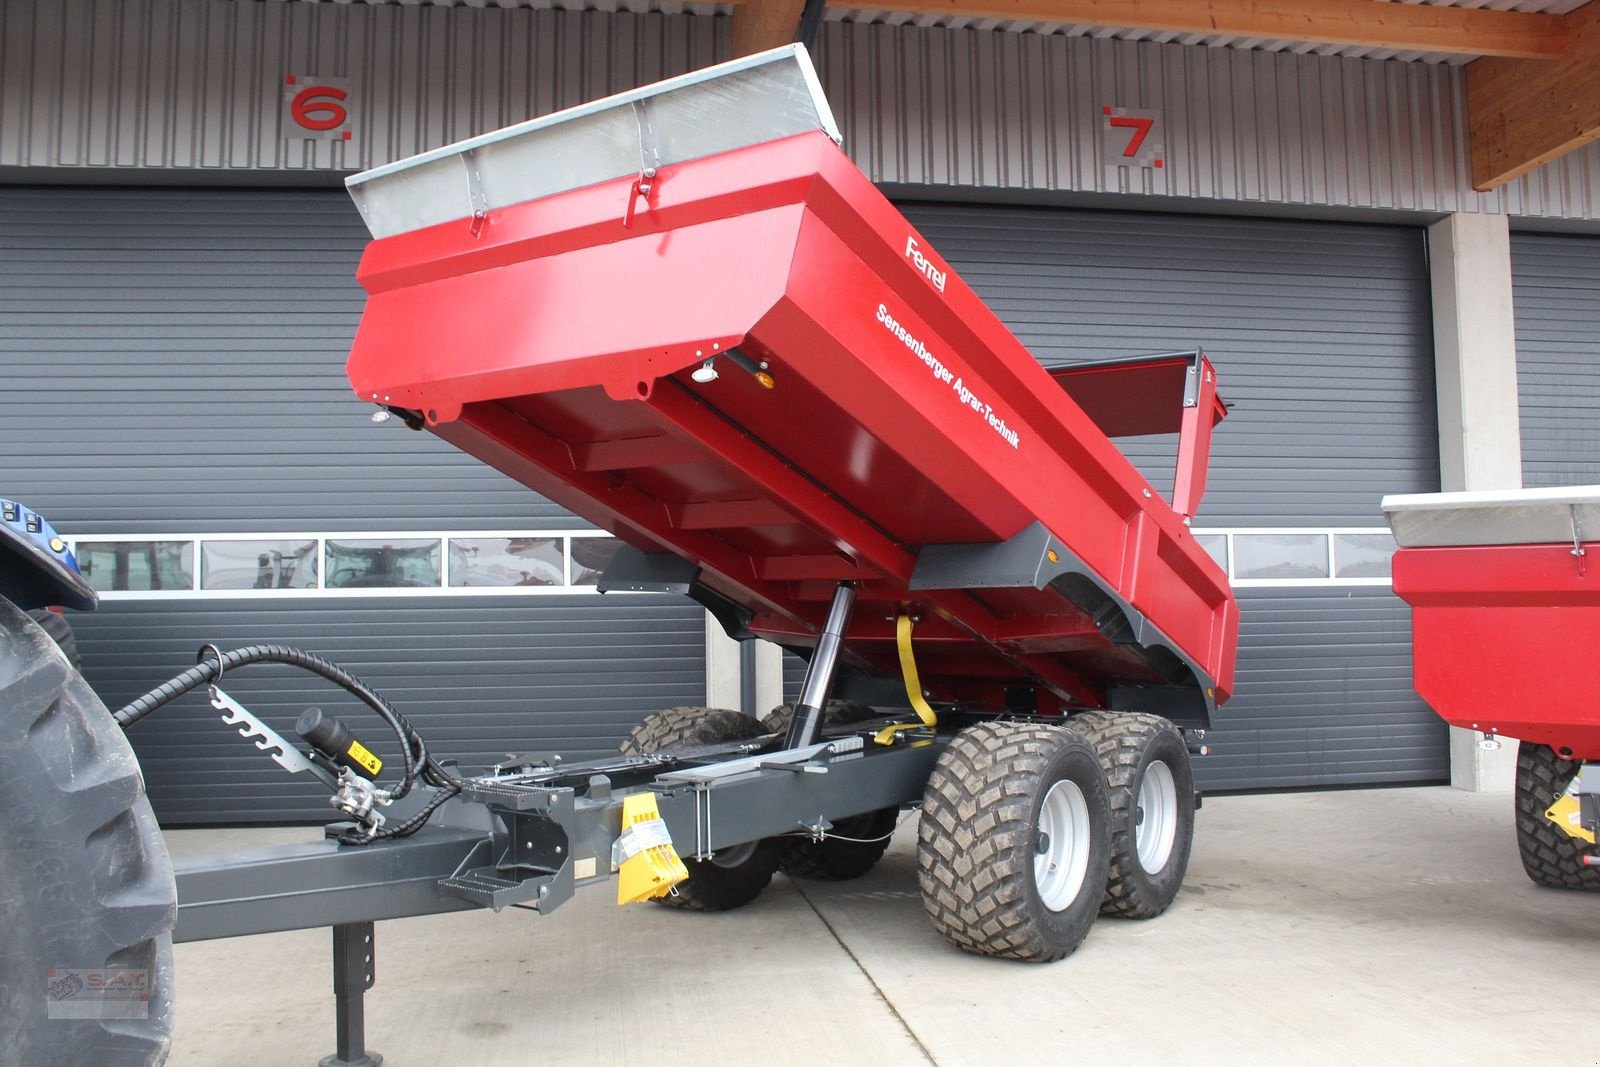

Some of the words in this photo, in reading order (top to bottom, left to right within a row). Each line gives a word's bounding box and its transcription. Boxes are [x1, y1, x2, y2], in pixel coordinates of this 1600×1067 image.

[290, 86, 348, 131] 6
[1110, 117, 1154, 157] 7
[905, 235, 946, 293] Ferrel
[876, 303, 954, 384] Sensenberger
[953, 377, 1020, 449] Agrar-Technik
